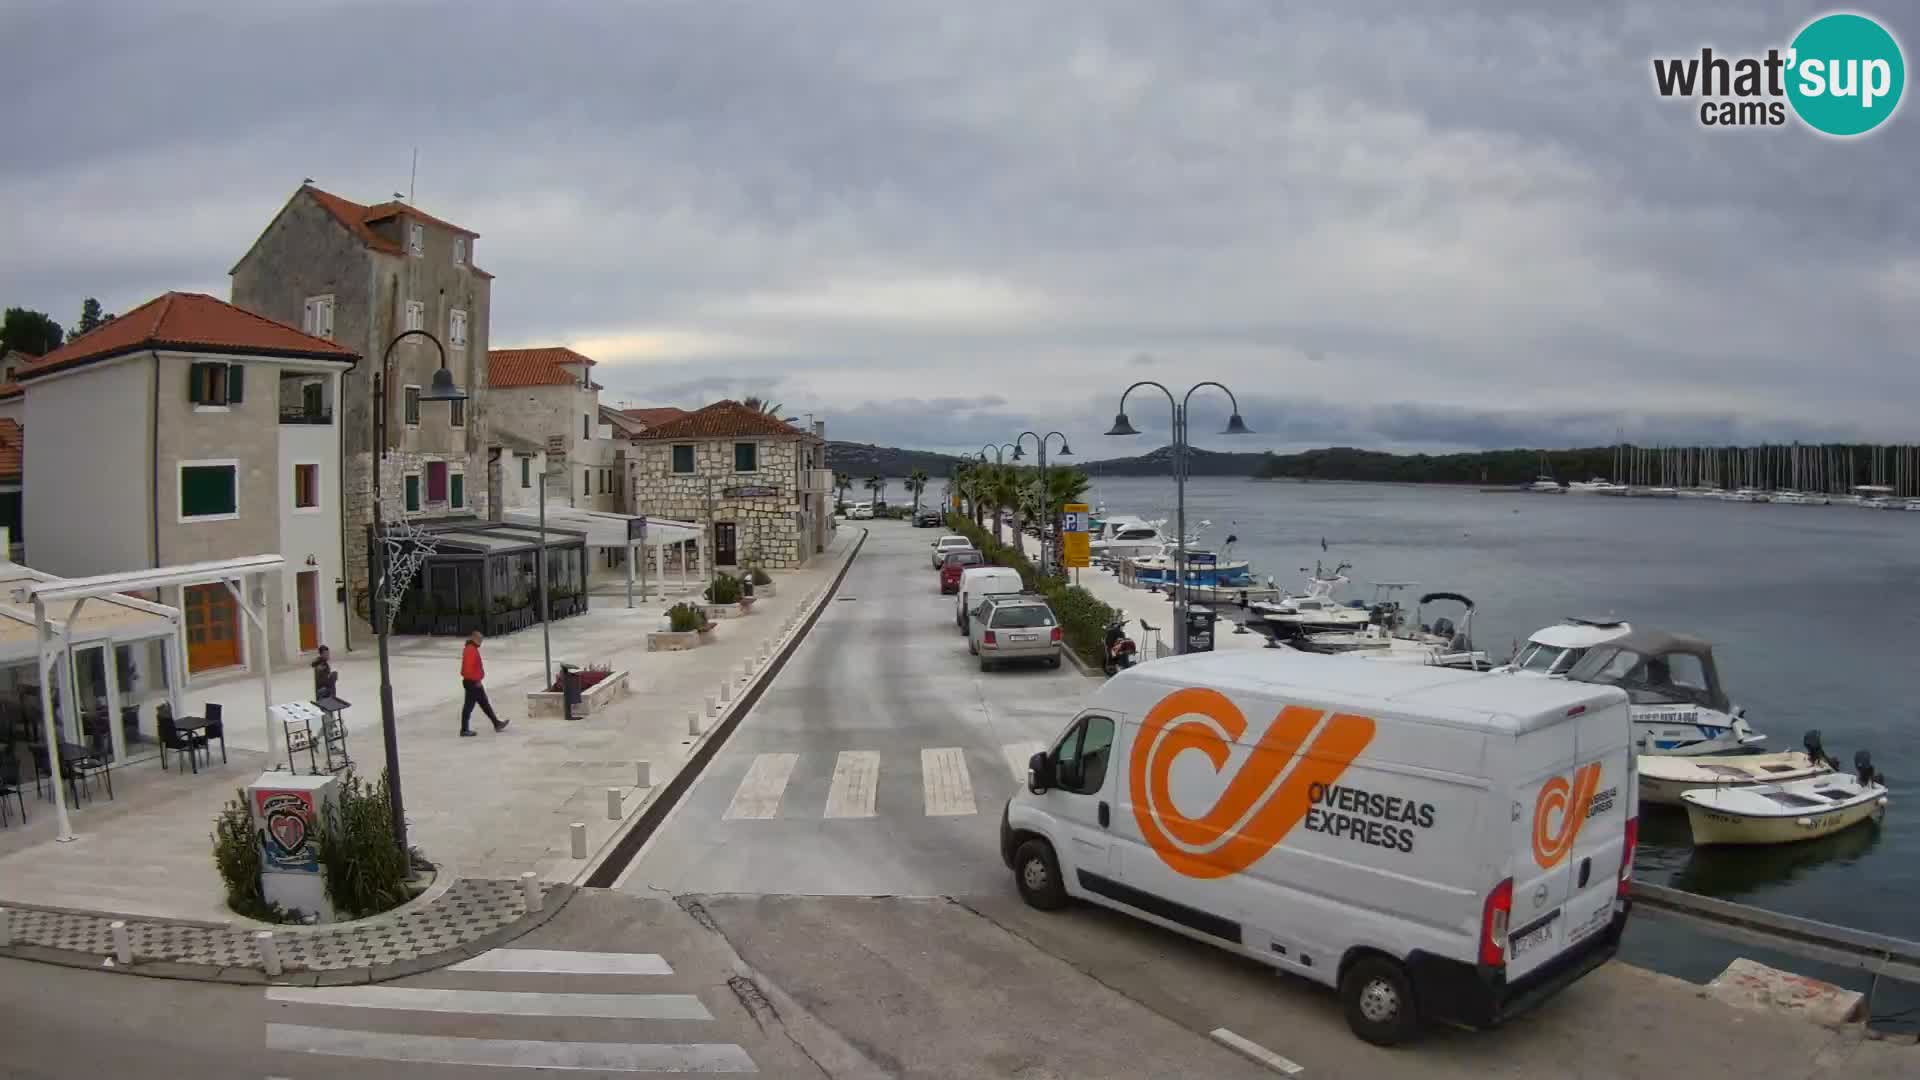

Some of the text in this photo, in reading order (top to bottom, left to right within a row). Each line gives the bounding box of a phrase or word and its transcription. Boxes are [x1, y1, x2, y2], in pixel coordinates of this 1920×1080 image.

[1066, 514, 1076, 530] P
[1308, 782, 1435, 828] OVERSEAS
[1304, 808, 1414, 853] EXPRESS
